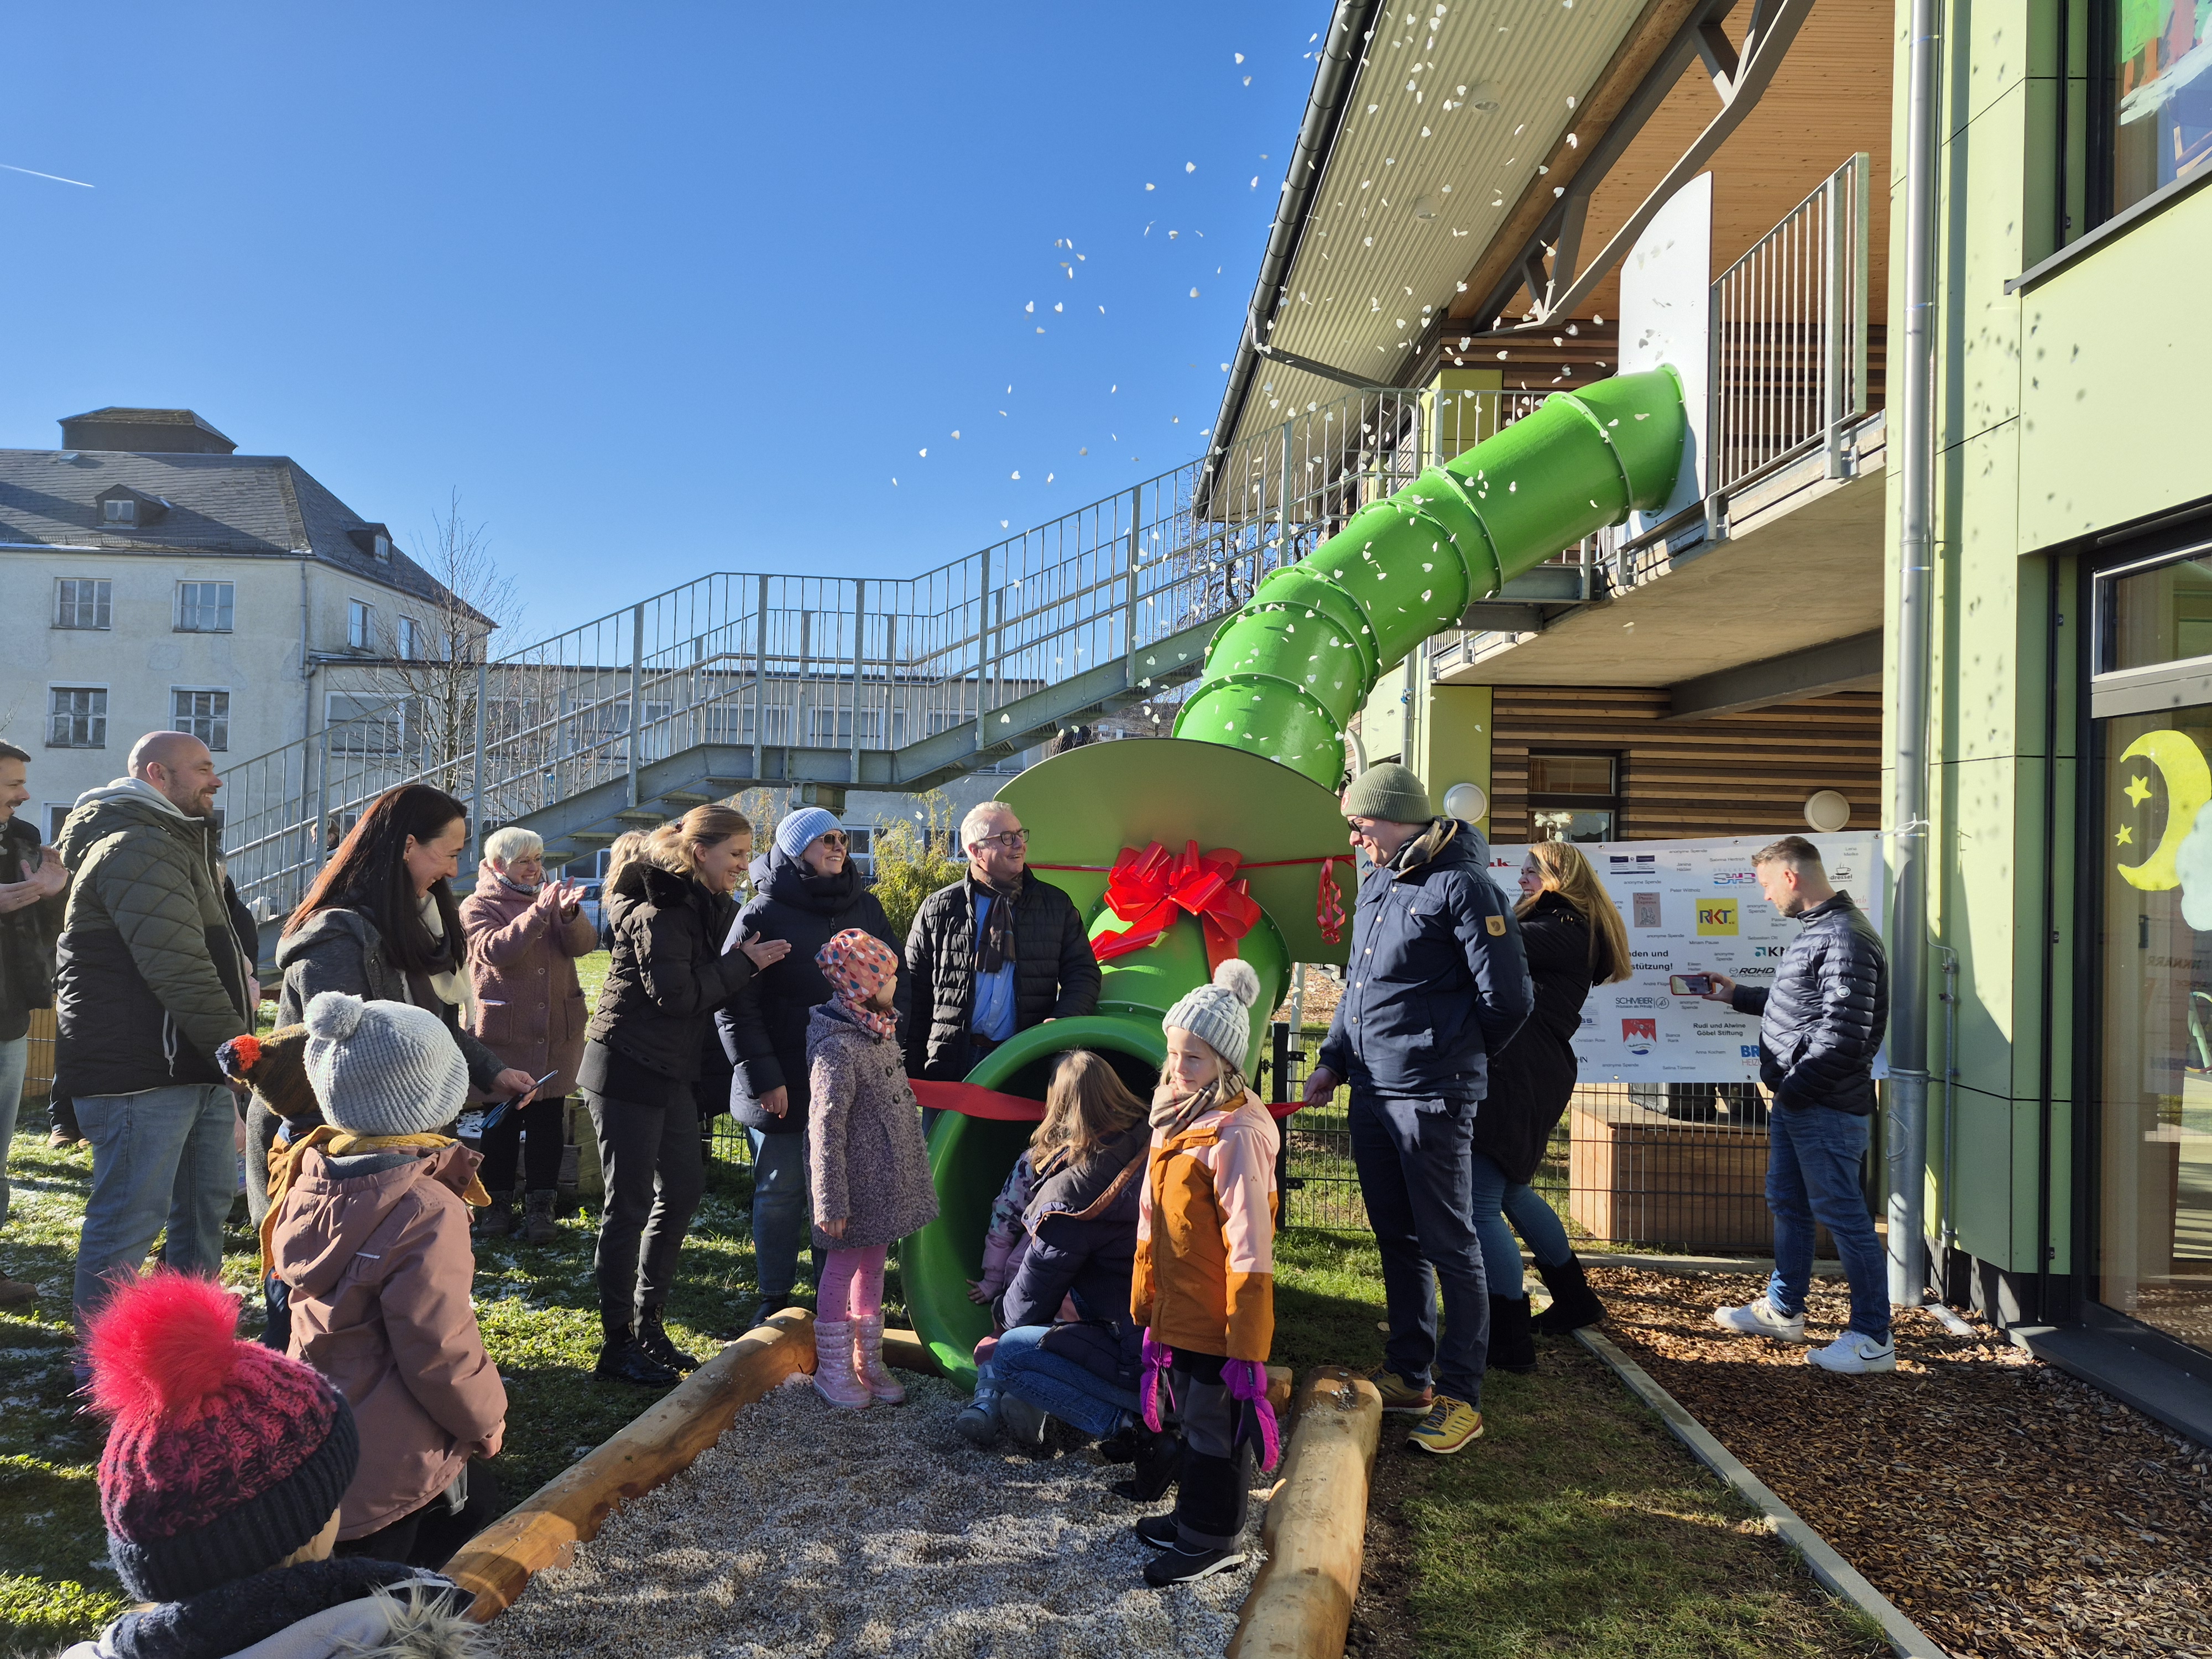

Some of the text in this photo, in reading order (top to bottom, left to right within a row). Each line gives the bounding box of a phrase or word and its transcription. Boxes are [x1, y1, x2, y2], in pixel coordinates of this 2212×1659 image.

[1699, 909, 1732, 925] RKT
[1630, 963, 1673, 971] stützung!
[1740, 1045, 1760, 1057] BR
